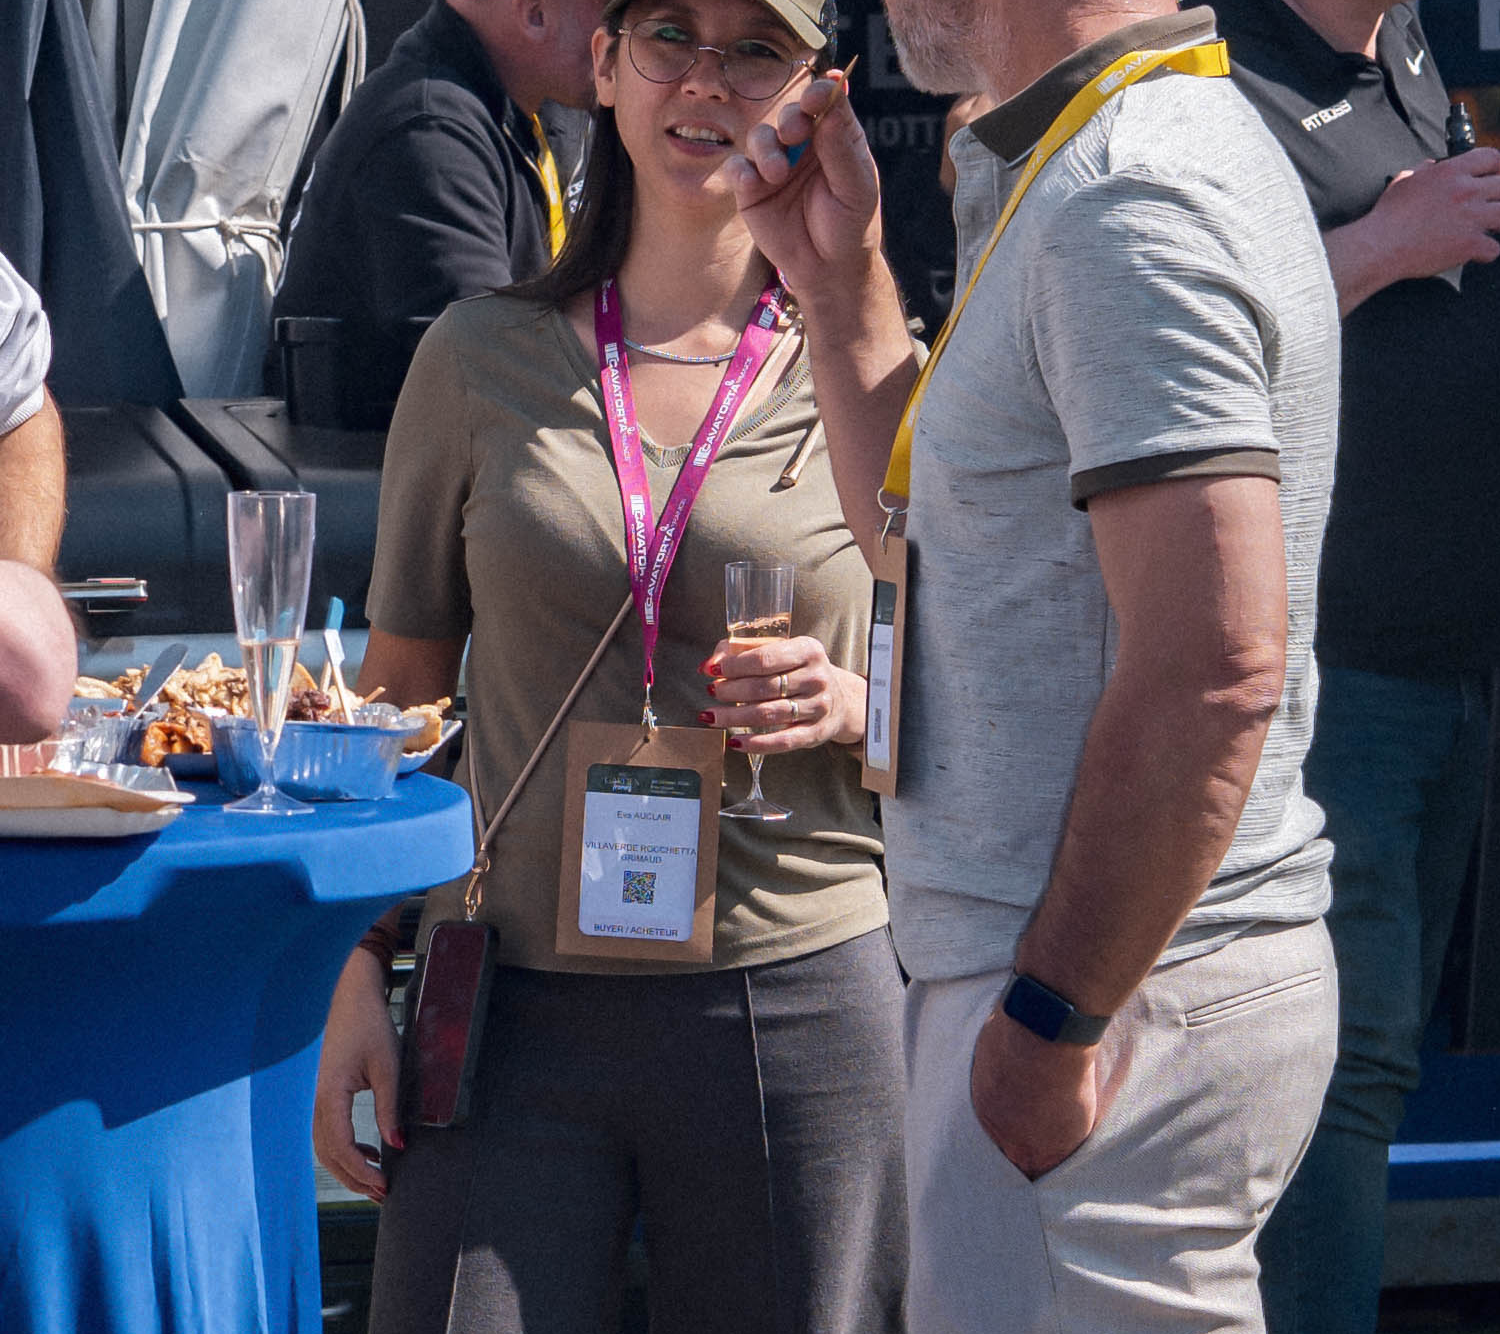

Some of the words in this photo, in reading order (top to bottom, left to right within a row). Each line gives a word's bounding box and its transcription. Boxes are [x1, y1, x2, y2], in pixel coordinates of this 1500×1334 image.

[608, 357, 628, 434] CAVATORTA
[701, 382, 742, 452] CAVATORTA
[646, 527, 676, 607] CAVATORTA
[593, 923, 624, 933] BUYER
[630, 926, 679, 937] ACHETEUR
